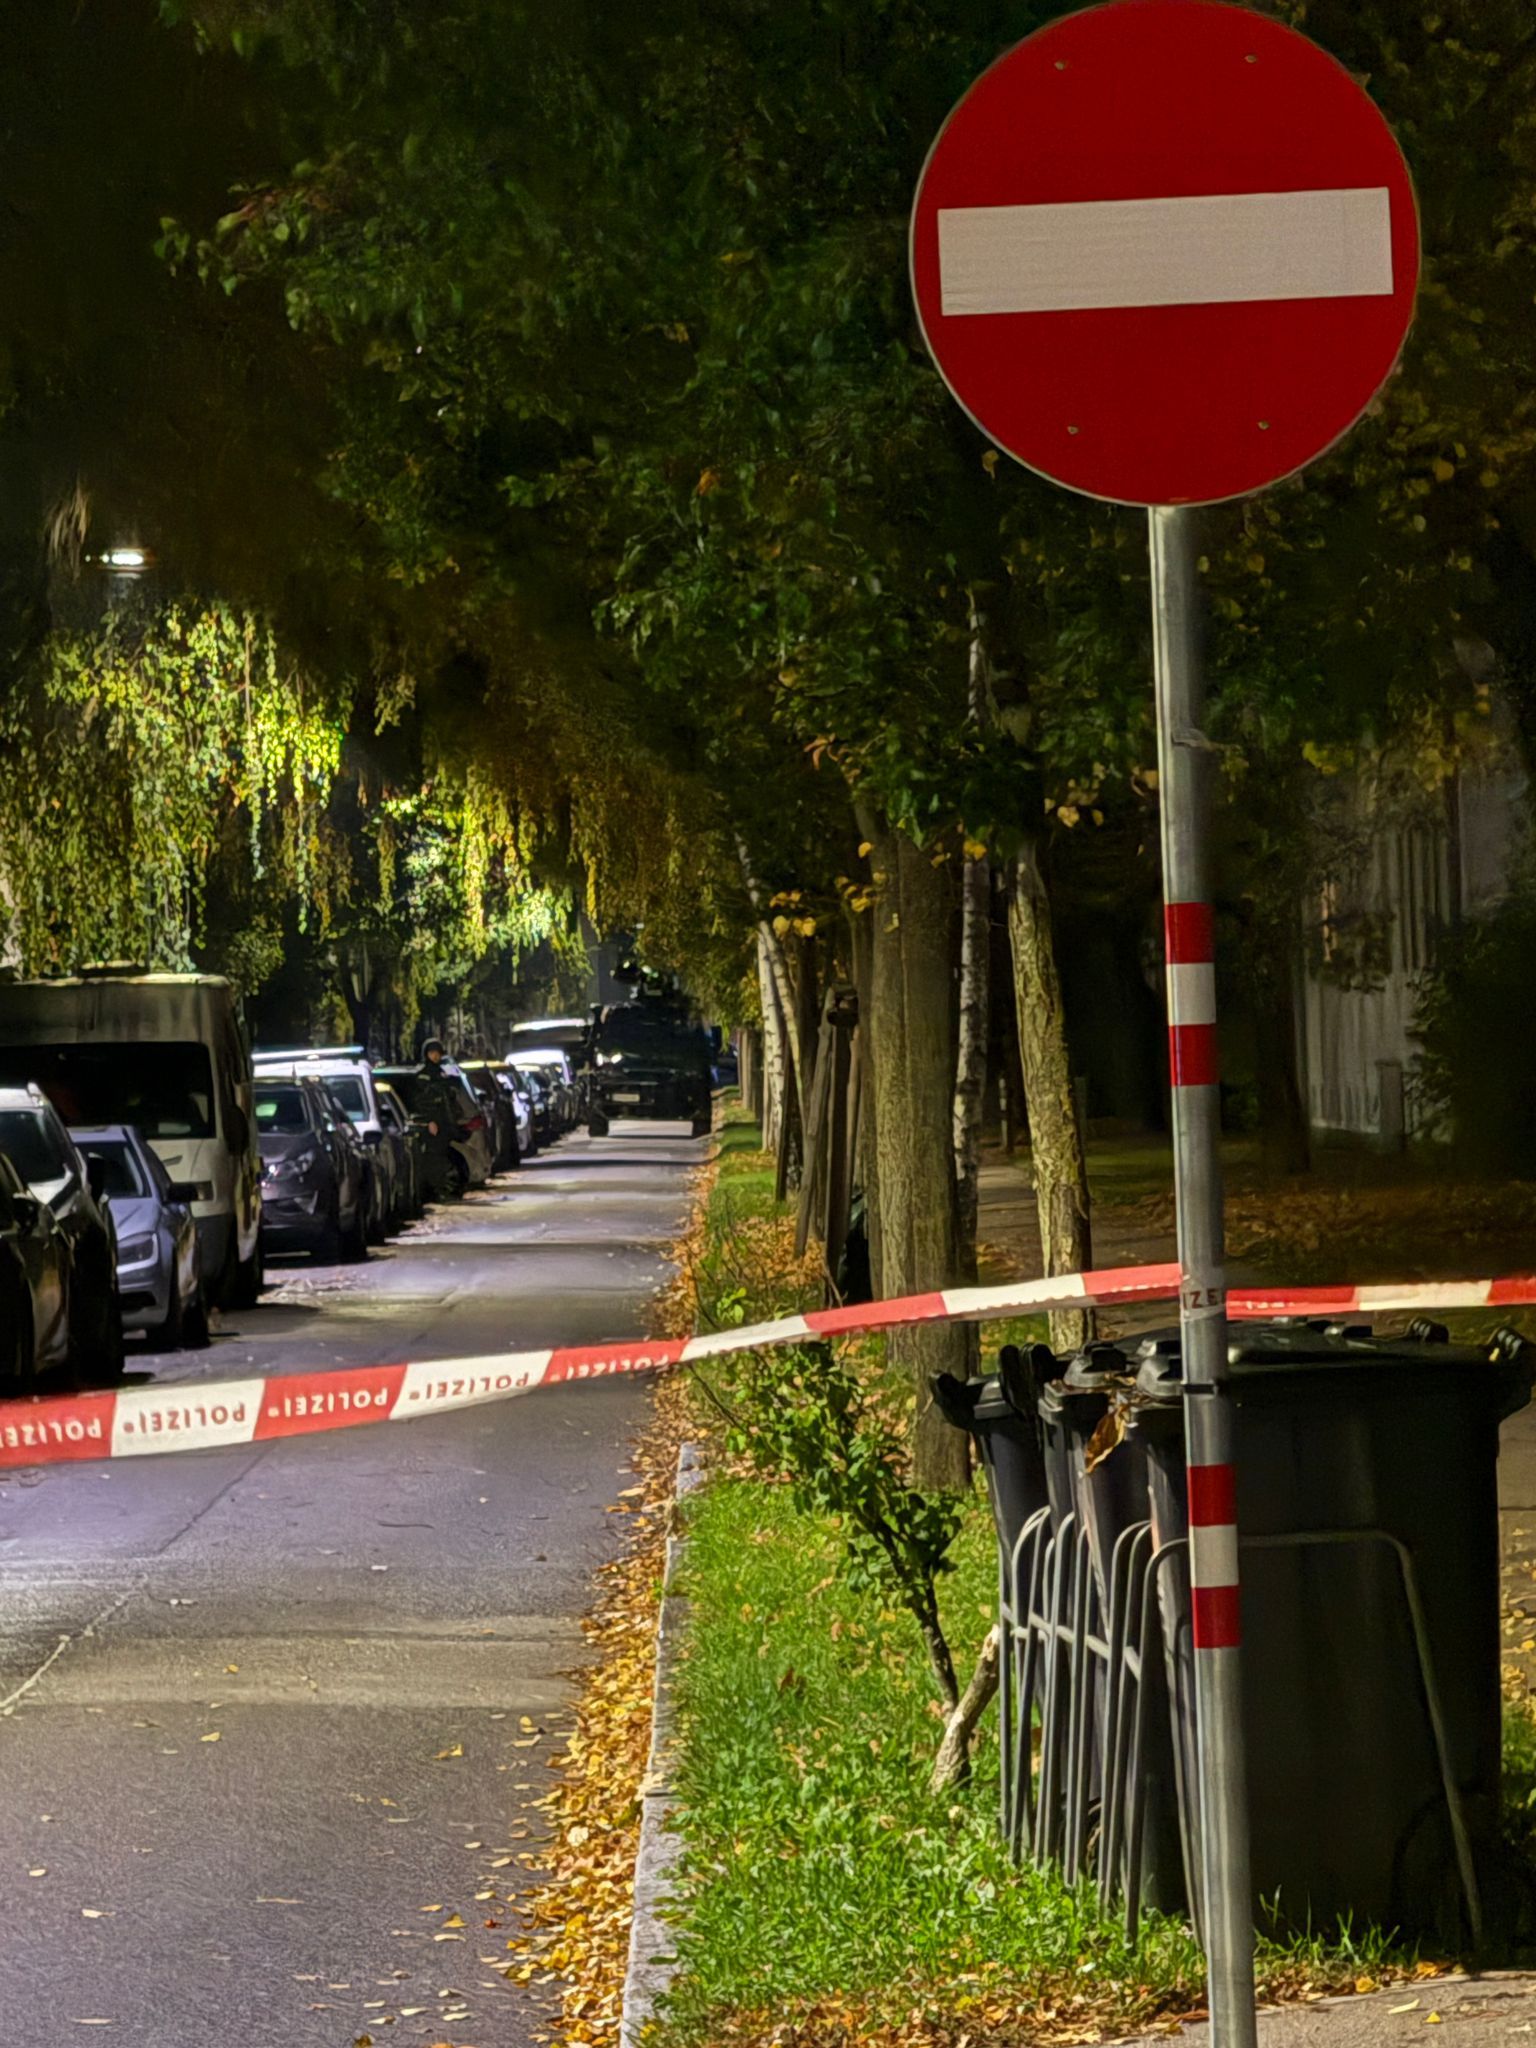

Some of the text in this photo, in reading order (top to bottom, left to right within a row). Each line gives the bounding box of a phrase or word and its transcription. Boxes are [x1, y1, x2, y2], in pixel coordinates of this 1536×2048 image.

[426, 1372, 529, 1399] POLIZEI
[284, 1387, 388, 1417] POLIZEI
[139, 1402, 245, 1433] POLIZEI
